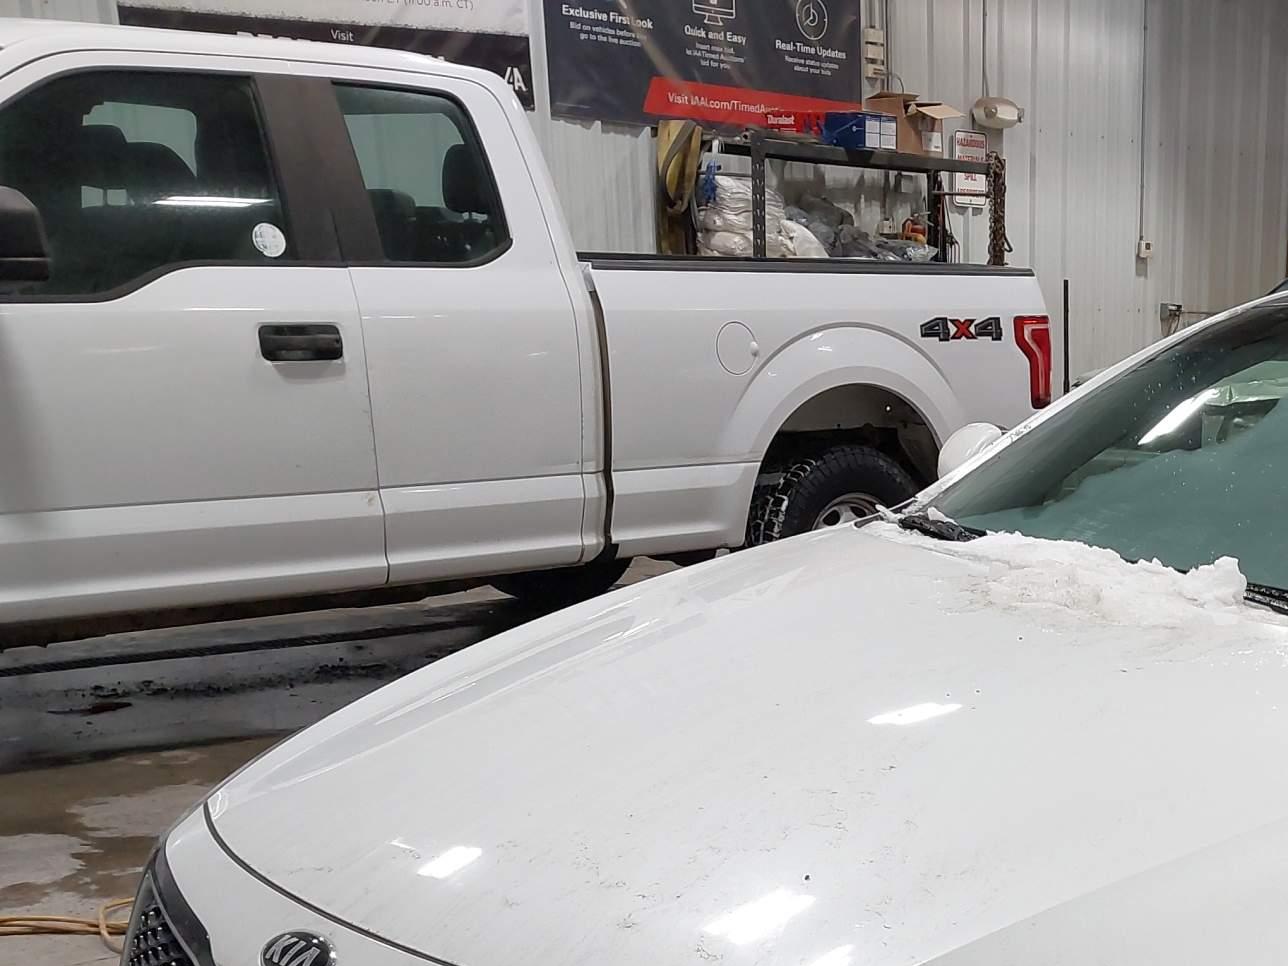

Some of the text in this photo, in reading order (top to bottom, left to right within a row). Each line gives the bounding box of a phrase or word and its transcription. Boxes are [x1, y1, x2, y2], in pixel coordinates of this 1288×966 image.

[561, 4, 653, 29] Exclusive First Look
[330, 28, 354, 42] Visit
[684, 25, 747, 46] Quick and Easy
[775, 39, 846, 59] Real-Time Updates
[667, 92, 689, 105] Visit
